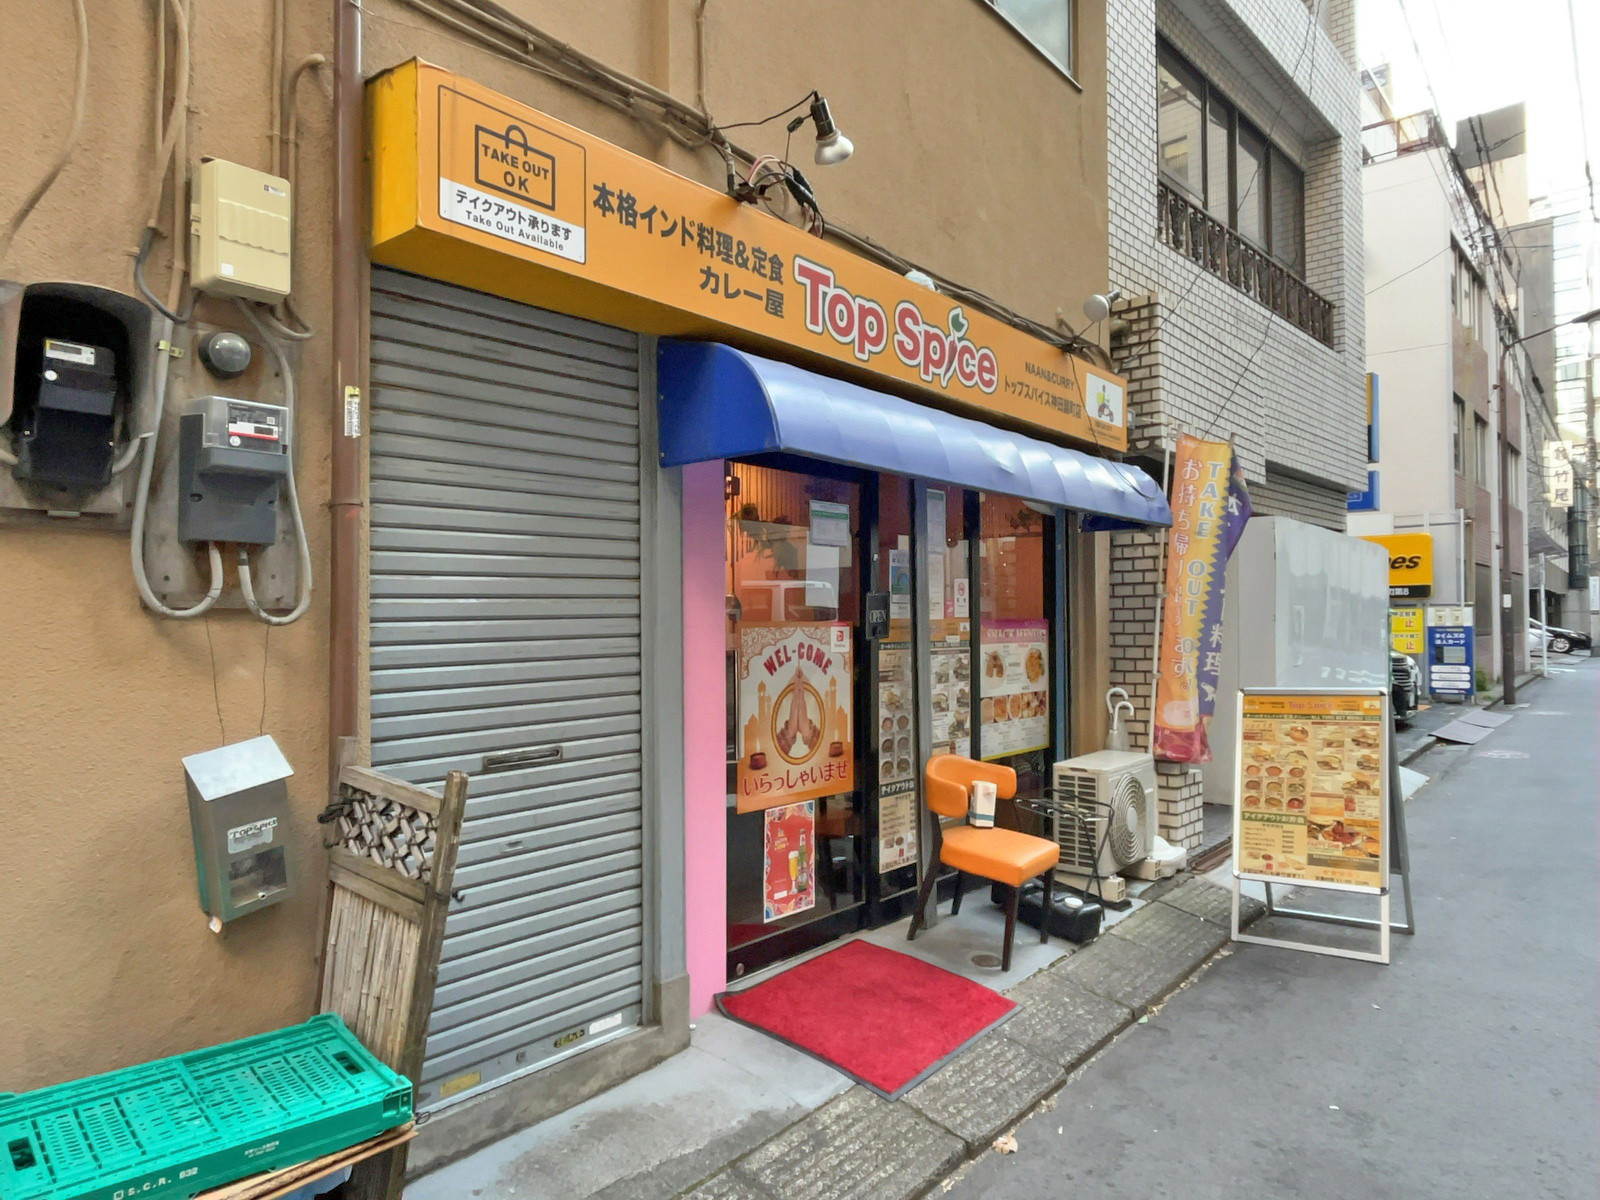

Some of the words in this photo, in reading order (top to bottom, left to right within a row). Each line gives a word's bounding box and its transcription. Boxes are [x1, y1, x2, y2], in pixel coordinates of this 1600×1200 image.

[481, 143, 519, 169] TAKE
[522, 161, 550, 180] OUT
[503, 170, 530, 194] OK
[456, 189, 573, 241] テイクアウト承ります
[465, 210, 492, 227] Take
[496, 221, 515, 235] Out
[518, 228, 564, 252] Available
[699, 265, 784, 319] カレー屋
[794, 257, 887, 359] Top
[894, 302, 998, 394] Spice
[1196, 461, 1224, 539] TAKE
[1389, 555, 1422, 570] es
[1187, 560, 1206, 617] OUT
[869, 609, 887, 623] OPEN
[1288, 701, 1305, 709] Top
[743, 760, 848, 796] いらっしゃいませ
